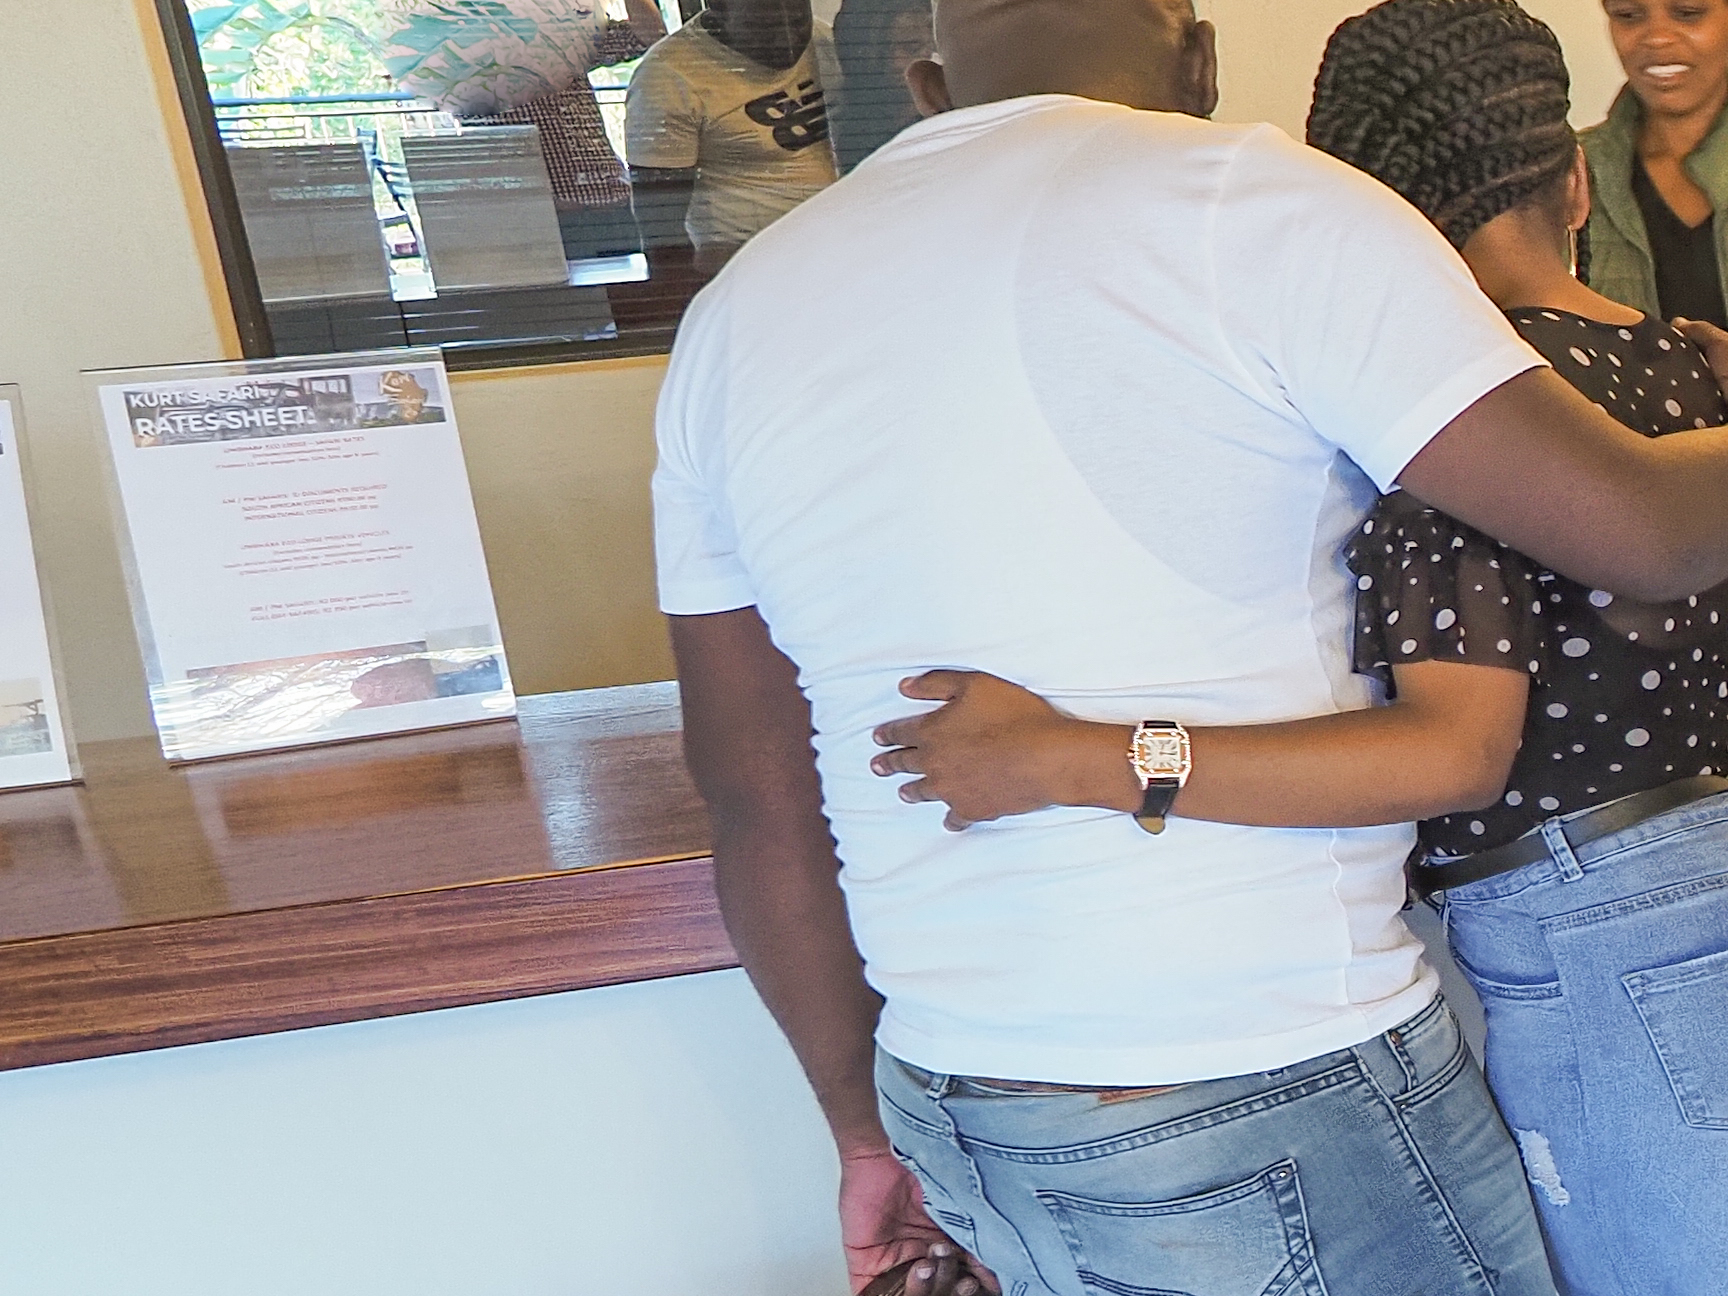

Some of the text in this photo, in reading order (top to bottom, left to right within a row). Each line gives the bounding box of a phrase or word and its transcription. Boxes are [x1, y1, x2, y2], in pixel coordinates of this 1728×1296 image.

[129, 384, 260, 409] KURT SAFARI
[136, 411, 218, 437] RATES
